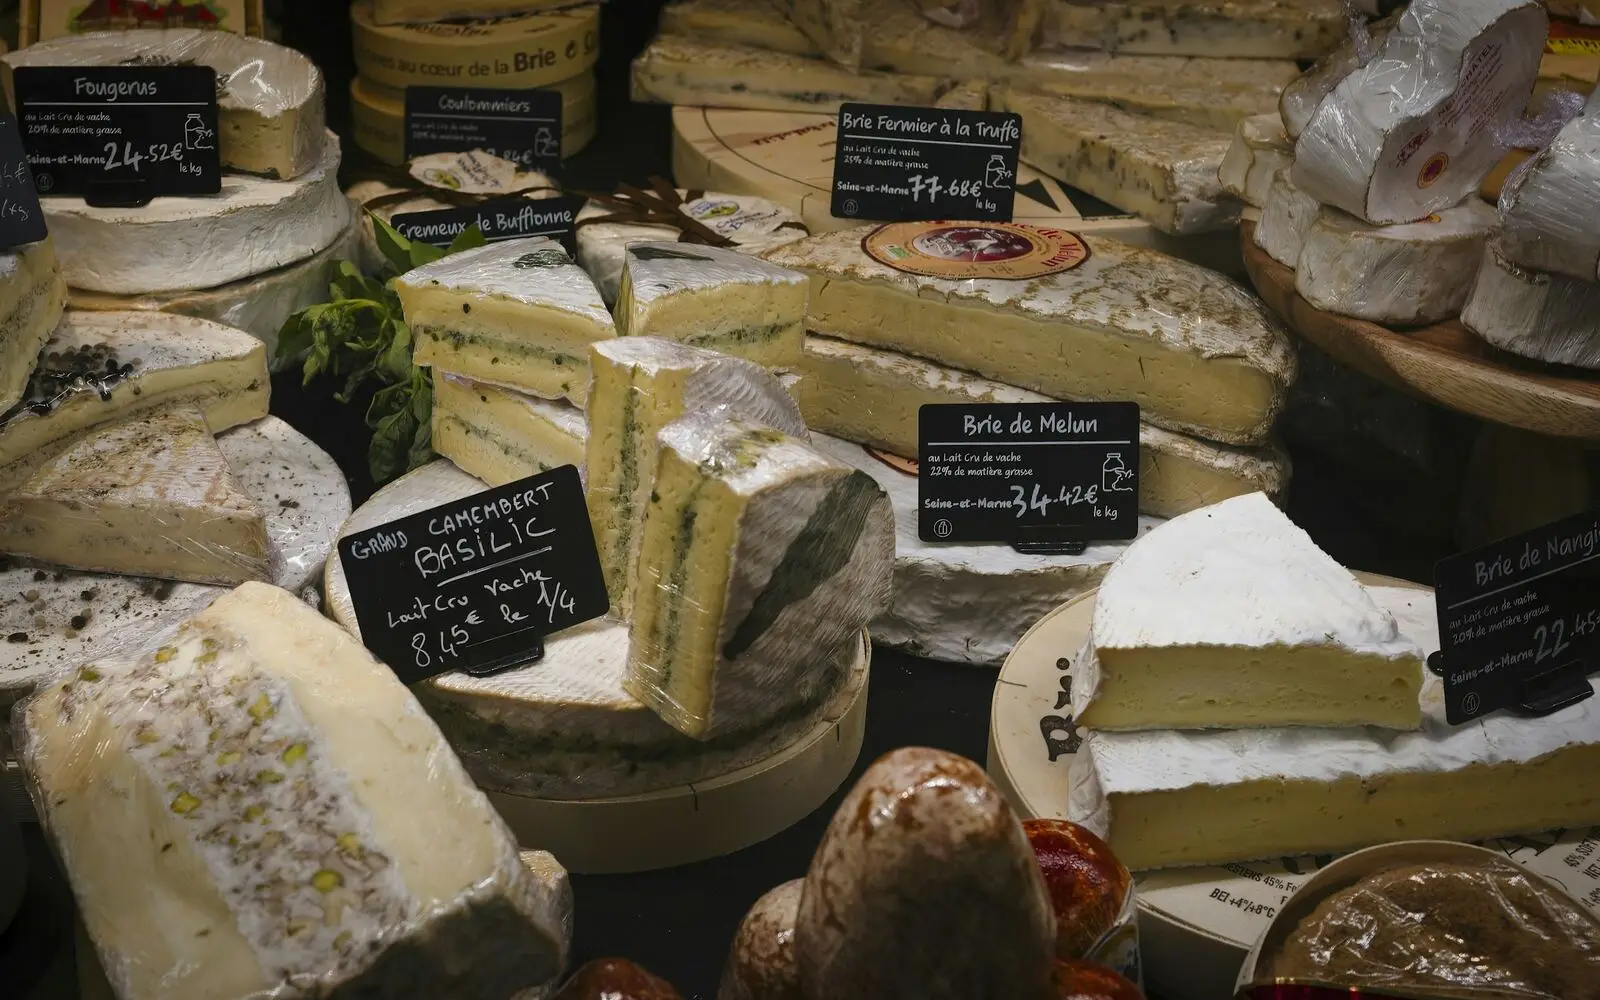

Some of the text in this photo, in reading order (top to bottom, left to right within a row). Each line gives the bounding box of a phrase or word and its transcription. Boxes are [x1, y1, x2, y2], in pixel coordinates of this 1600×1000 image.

[398, 58, 416, 74] au
[420, 63, 464, 78] cœur
[468, 60, 490, 78] de
[494, 58, 509, 75] la
[514, 48, 557, 73] Brie
[74, 77, 157, 102] Fougerus
[438, 93, 531, 113] Coulommiers
[25, 112, 111, 121] au Lait Cru de vache
[28, 124, 123, 137] 20% de matière grasse
[842, 112, 1020, 142] Brie Fermier à la Truffe
[25, 150, 106, 164] Seine-et-Marne
[843, 144, 854, 152] au
[855, 144, 871, 153] Lait
[872, 145, 887, 155] Cru
[888, 146, 897, 155] de
[179, 162, 202, 176] le kg
[843, 155, 862, 164] 25%
[863, 156, 873, 165] de
[874, 158, 904, 168] matière
[836, 180, 909, 196] Seine-et-Marne
[975, 199, 997, 213] le kg
[397, 221, 467, 239] Cremeux
[496, 205, 573, 232] Bufflonne
[963, 411, 1099, 437] Brie de Melun
[928, 452, 1022, 463] au Lait Cru de vache
[929, 466, 1034, 480] 22% de matière grasse
[924, 497, 1012, 510] Seine-et-Marne
[351, 482, 553, 560] GRAND CAMEMBERT
[1093, 505, 1118, 521] le kg
[1475, 521, 1600, 586] Brie de Nangi
[500, 604, 529, 625] le
[536, 580, 576, 623] 1/4
[1448, 590, 1538, 630] au Lait Cru de vache
[1452, 604, 1550, 646] 20% de matière grasse
[1450, 648, 1534, 686] Seine-et-Marne
[1223, 862, 1263, 882] ESTENS
[1263, 876, 1284, 889] 45%
[1209, 887, 1230, 903] BEI
